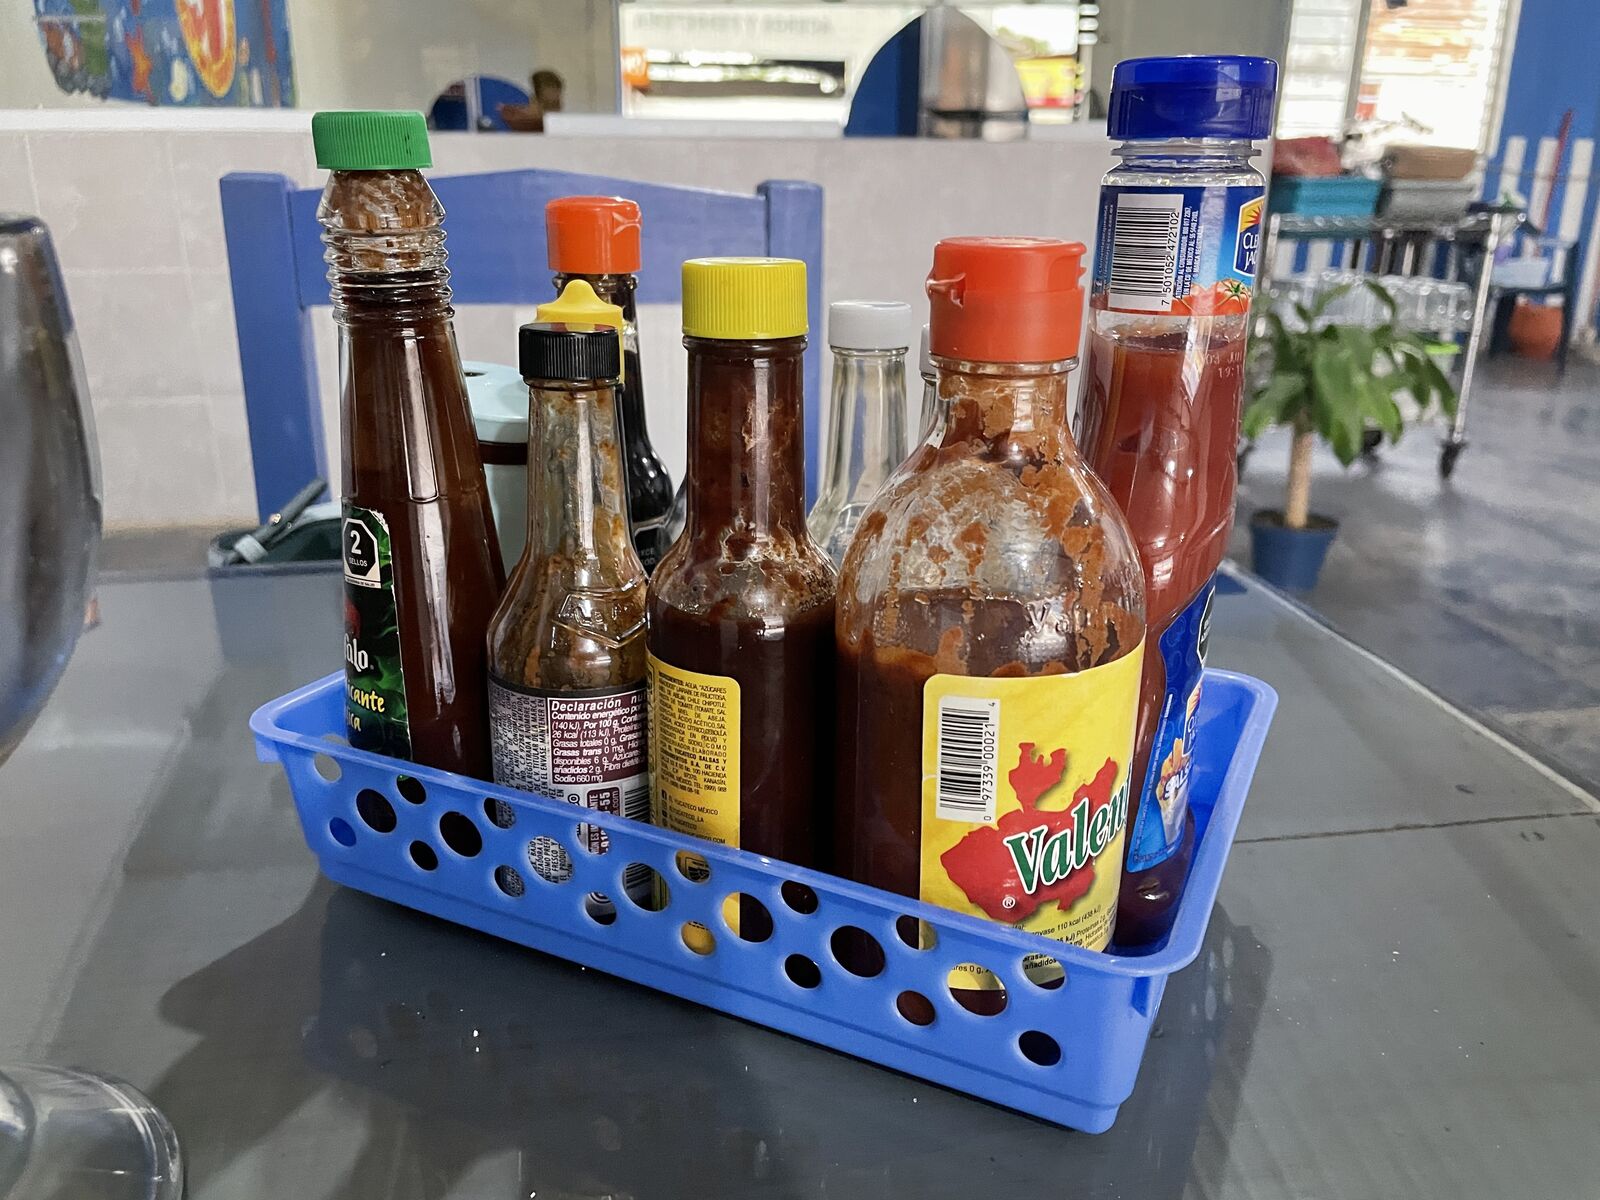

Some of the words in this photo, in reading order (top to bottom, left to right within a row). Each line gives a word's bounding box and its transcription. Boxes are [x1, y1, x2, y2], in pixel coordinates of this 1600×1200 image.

[1162, 254, 1175, 294] 501052
[1169, 211, 1180, 252] 472102
[350, 530, 362, 555] 2
[538, 699, 544, 707] EN
[551, 698, 621, 711] Declaración
[552, 712, 590, 720] Contenido
[592, 707, 629, 719] energético
[518, 724, 524, 732] EN
[531, 724, 537, 733] LA
[538, 709, 547, 744] MANTENER
[552, 722, 568, 730] (140
[599, 718, 611, 728] 100
[580, 730, 596, 739] (113
[552, 739, 578, 748] Grasas
[580, 738, 602, 747] totales
[604, 737, 608, 745] 0
[984, 723, 996, 760] 00021
[675, 748, 696, 759] YUCATECO
[553, 757, 591, 767] disponibles
[553, 766, 587, 774] añadidos
[604, 762, 621, 771] Fibra
[554, 774, 575, 782] Sodio
[591, 774, 602, 783] mg
[982, 766, 994, 800] 97339
[698, 806, 718, 815] MÉXICO
[1057, 922, 1068, 932] 110
[1069, 916, 1081, 926] kcal
[1025, 958, 1057, 970] añadidos
